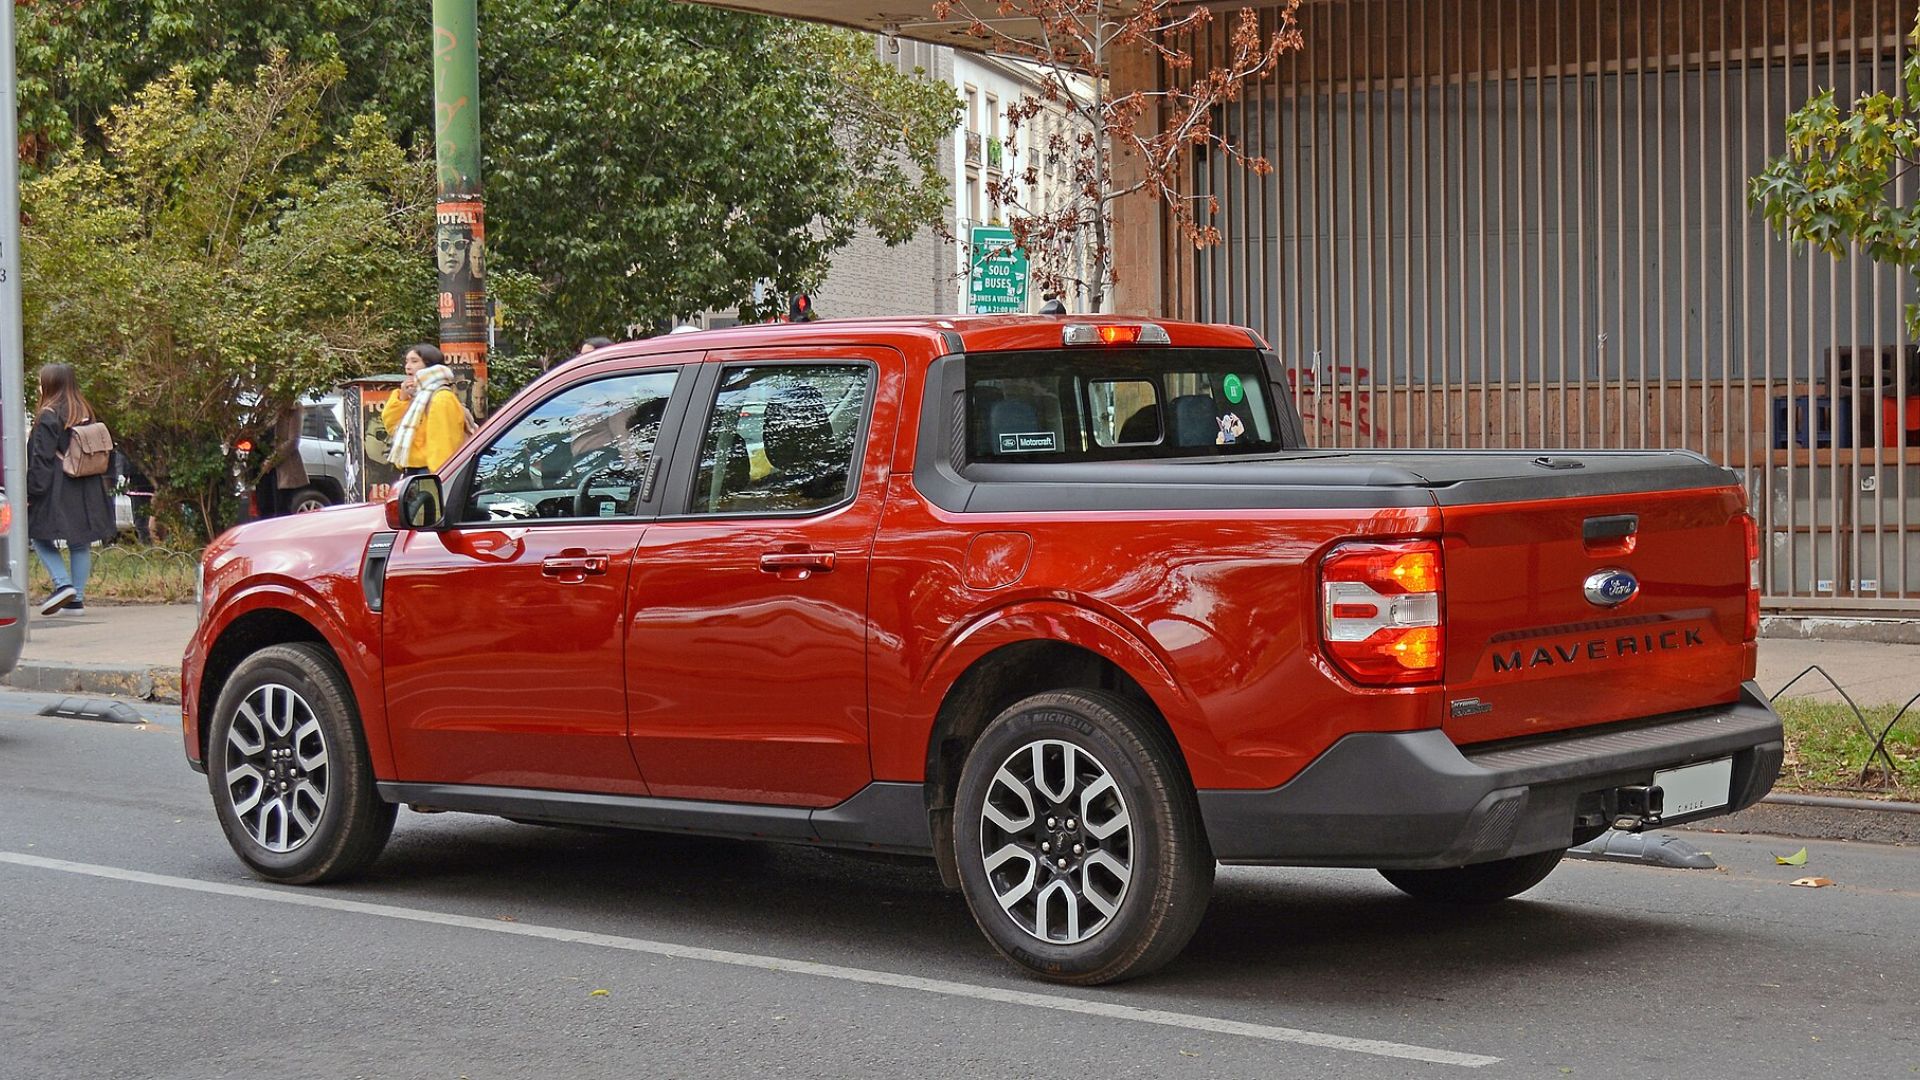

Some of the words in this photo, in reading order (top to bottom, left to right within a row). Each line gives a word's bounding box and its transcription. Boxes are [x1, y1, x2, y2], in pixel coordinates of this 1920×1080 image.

[988, 265, 1010, 276] SOLO
[985, 278, 1012, 289] BUSES
[439, 291, 453, 308] 18
[992, 295, 997, 303] A
[444, 352, 479, 365] OTAL
[1609, 580, 1632, 596] Ford
[1491, 627, 1705, 673] MAVERICK
[1032, 713, 1094, 736] MICHELIN
[1677, 800, 1704, 812] CHILE
